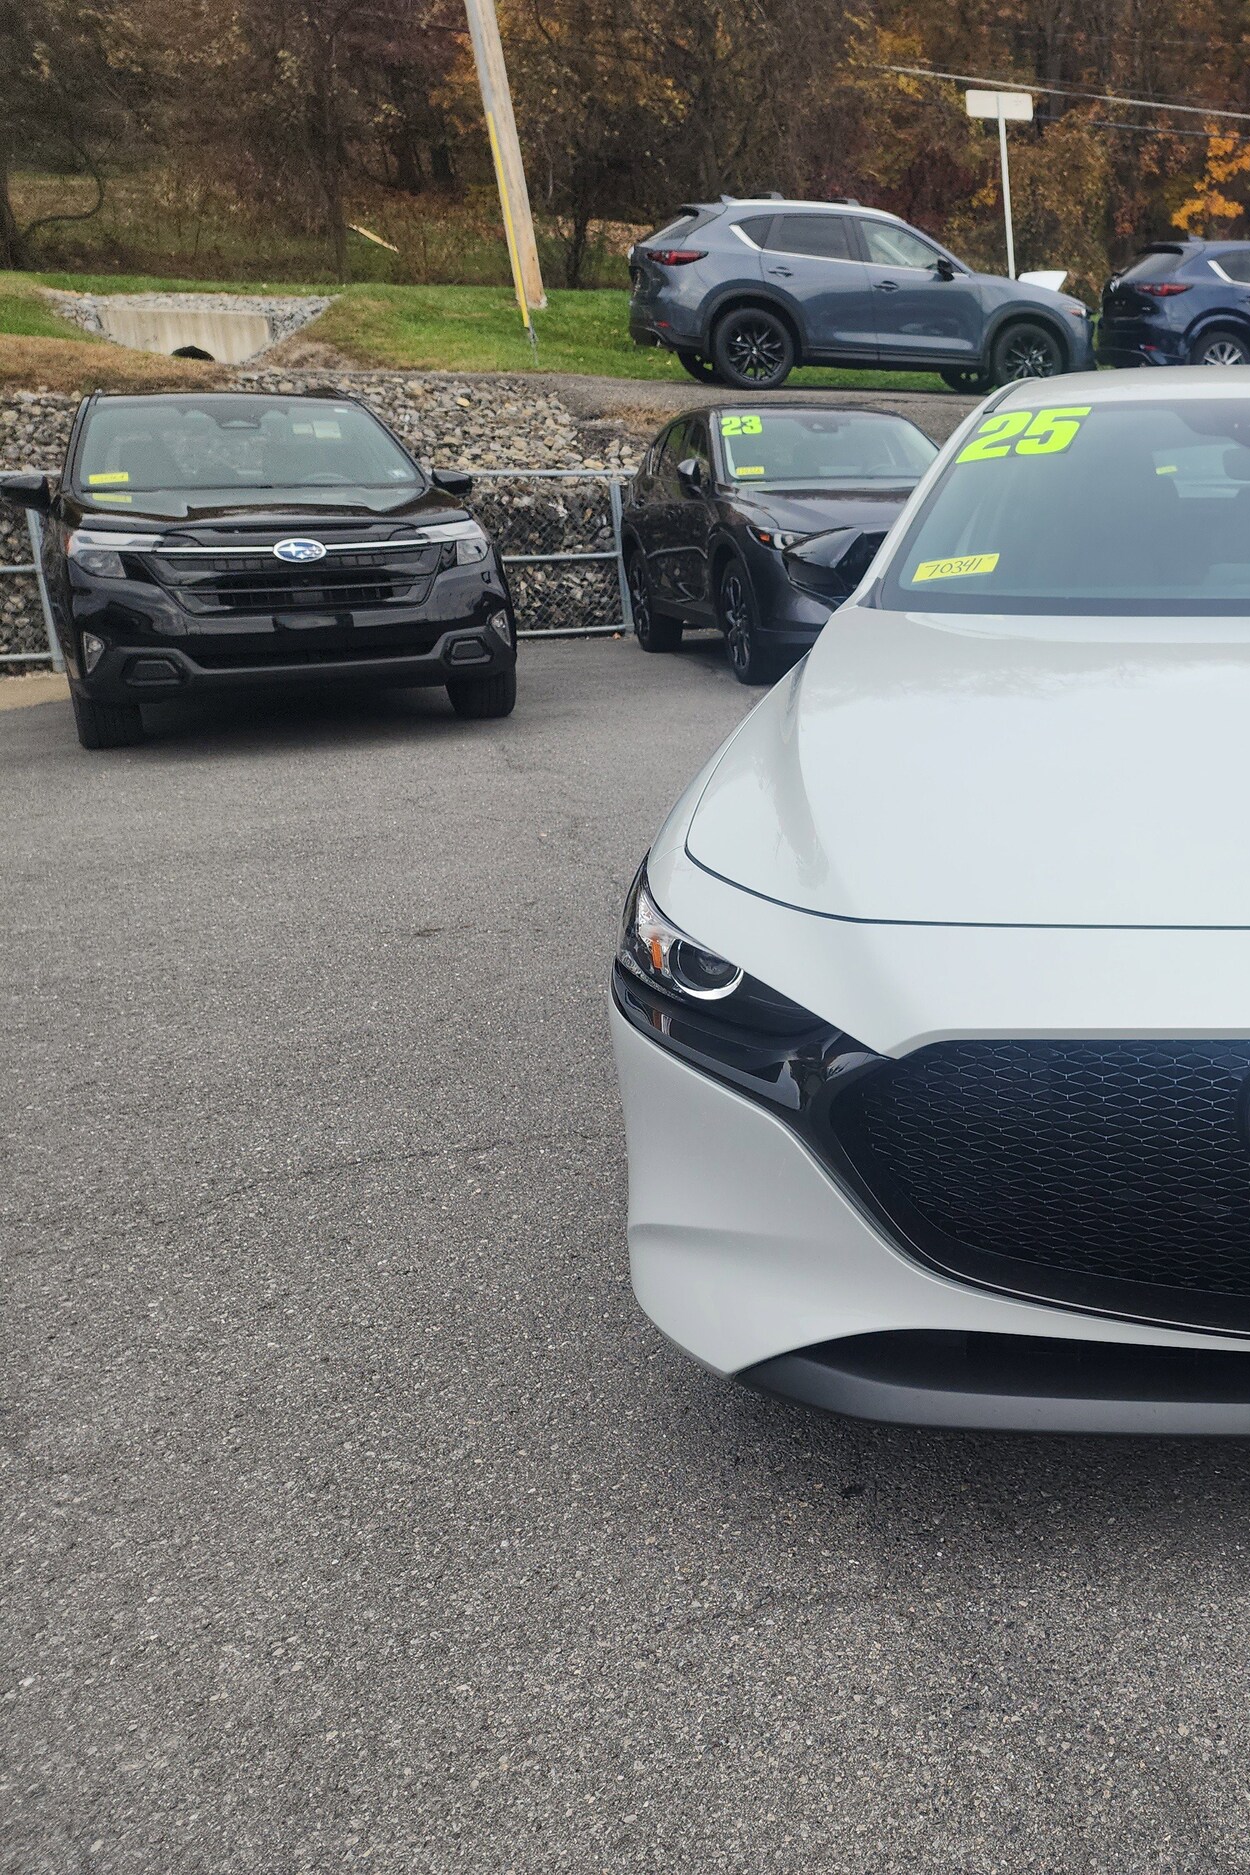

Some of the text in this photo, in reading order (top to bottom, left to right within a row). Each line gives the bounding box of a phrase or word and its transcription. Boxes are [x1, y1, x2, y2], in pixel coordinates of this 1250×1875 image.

[721, 415, 763, 436] 23
[955, 407, 1092, 464] 25
[925, 557, 983, 577] 70341
